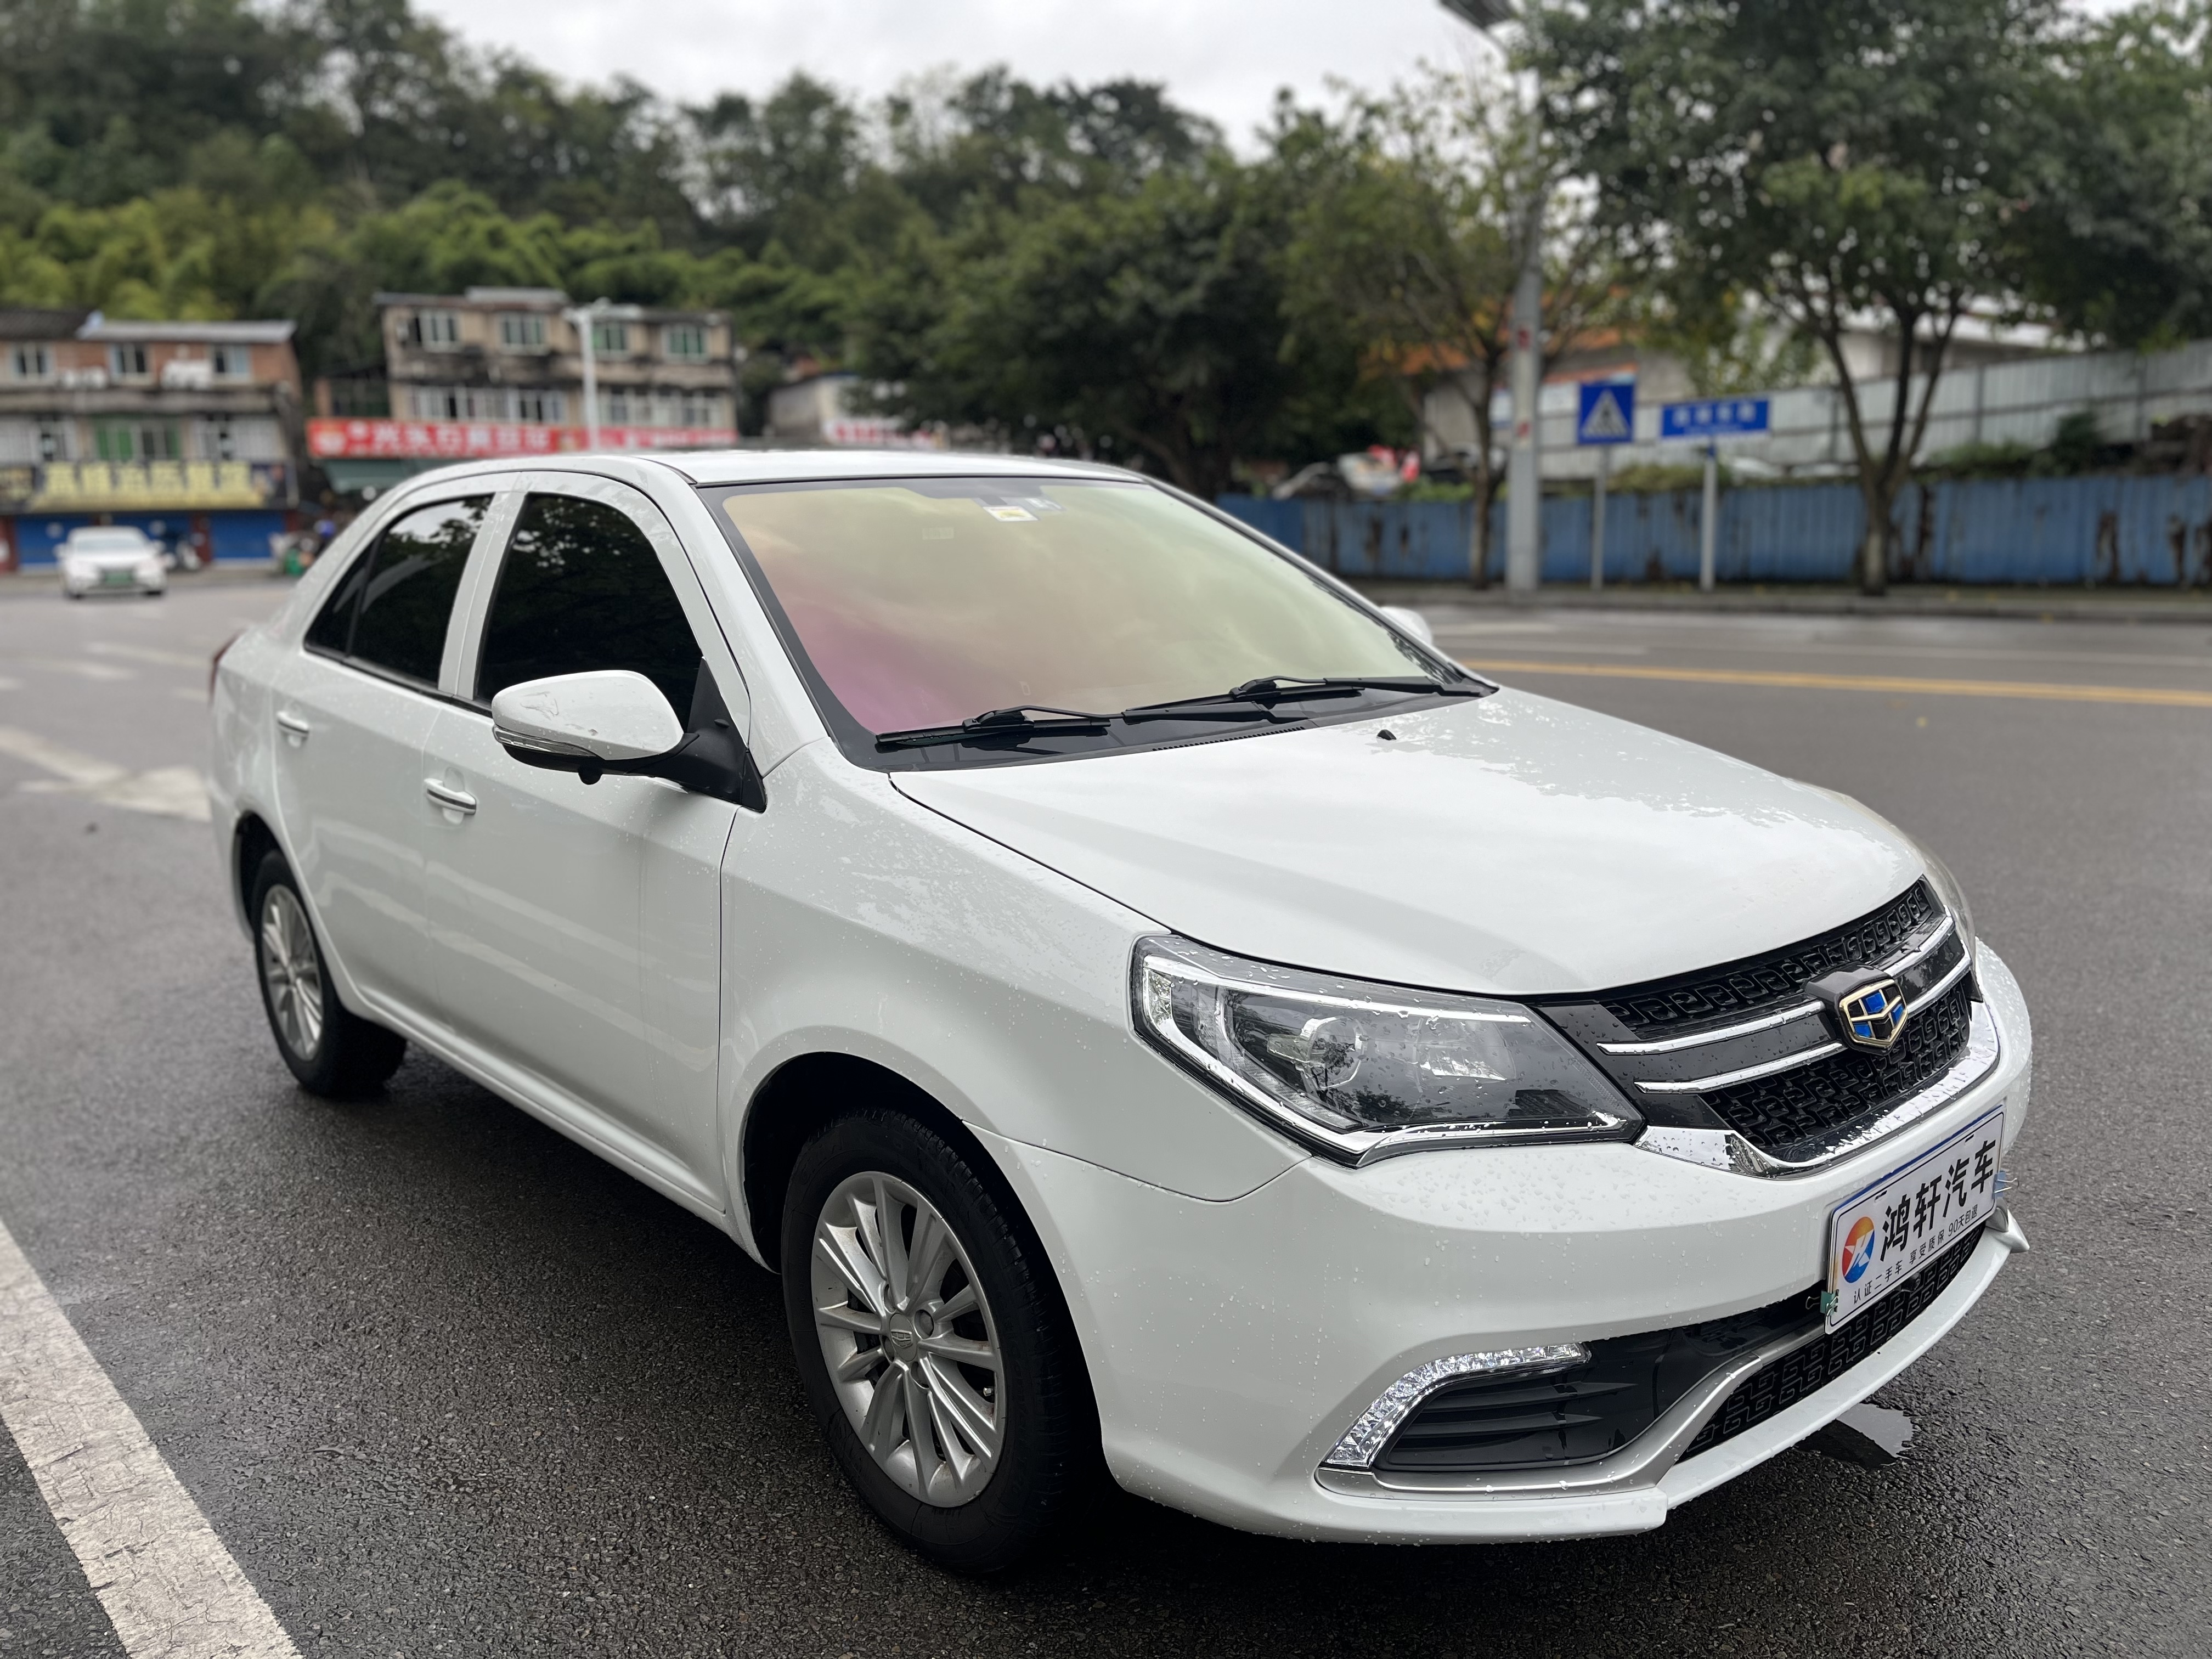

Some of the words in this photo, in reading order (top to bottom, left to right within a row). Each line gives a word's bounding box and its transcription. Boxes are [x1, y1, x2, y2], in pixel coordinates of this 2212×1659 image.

[1854, 1260, 1903, 1305] 认证二手车
[1909, 1229, 1945, 1265] 享受质保
[1948, 1204, 1978, 1237] 90天包退
[1880, 1139, 1996, 1262] 鸿轩汽车
